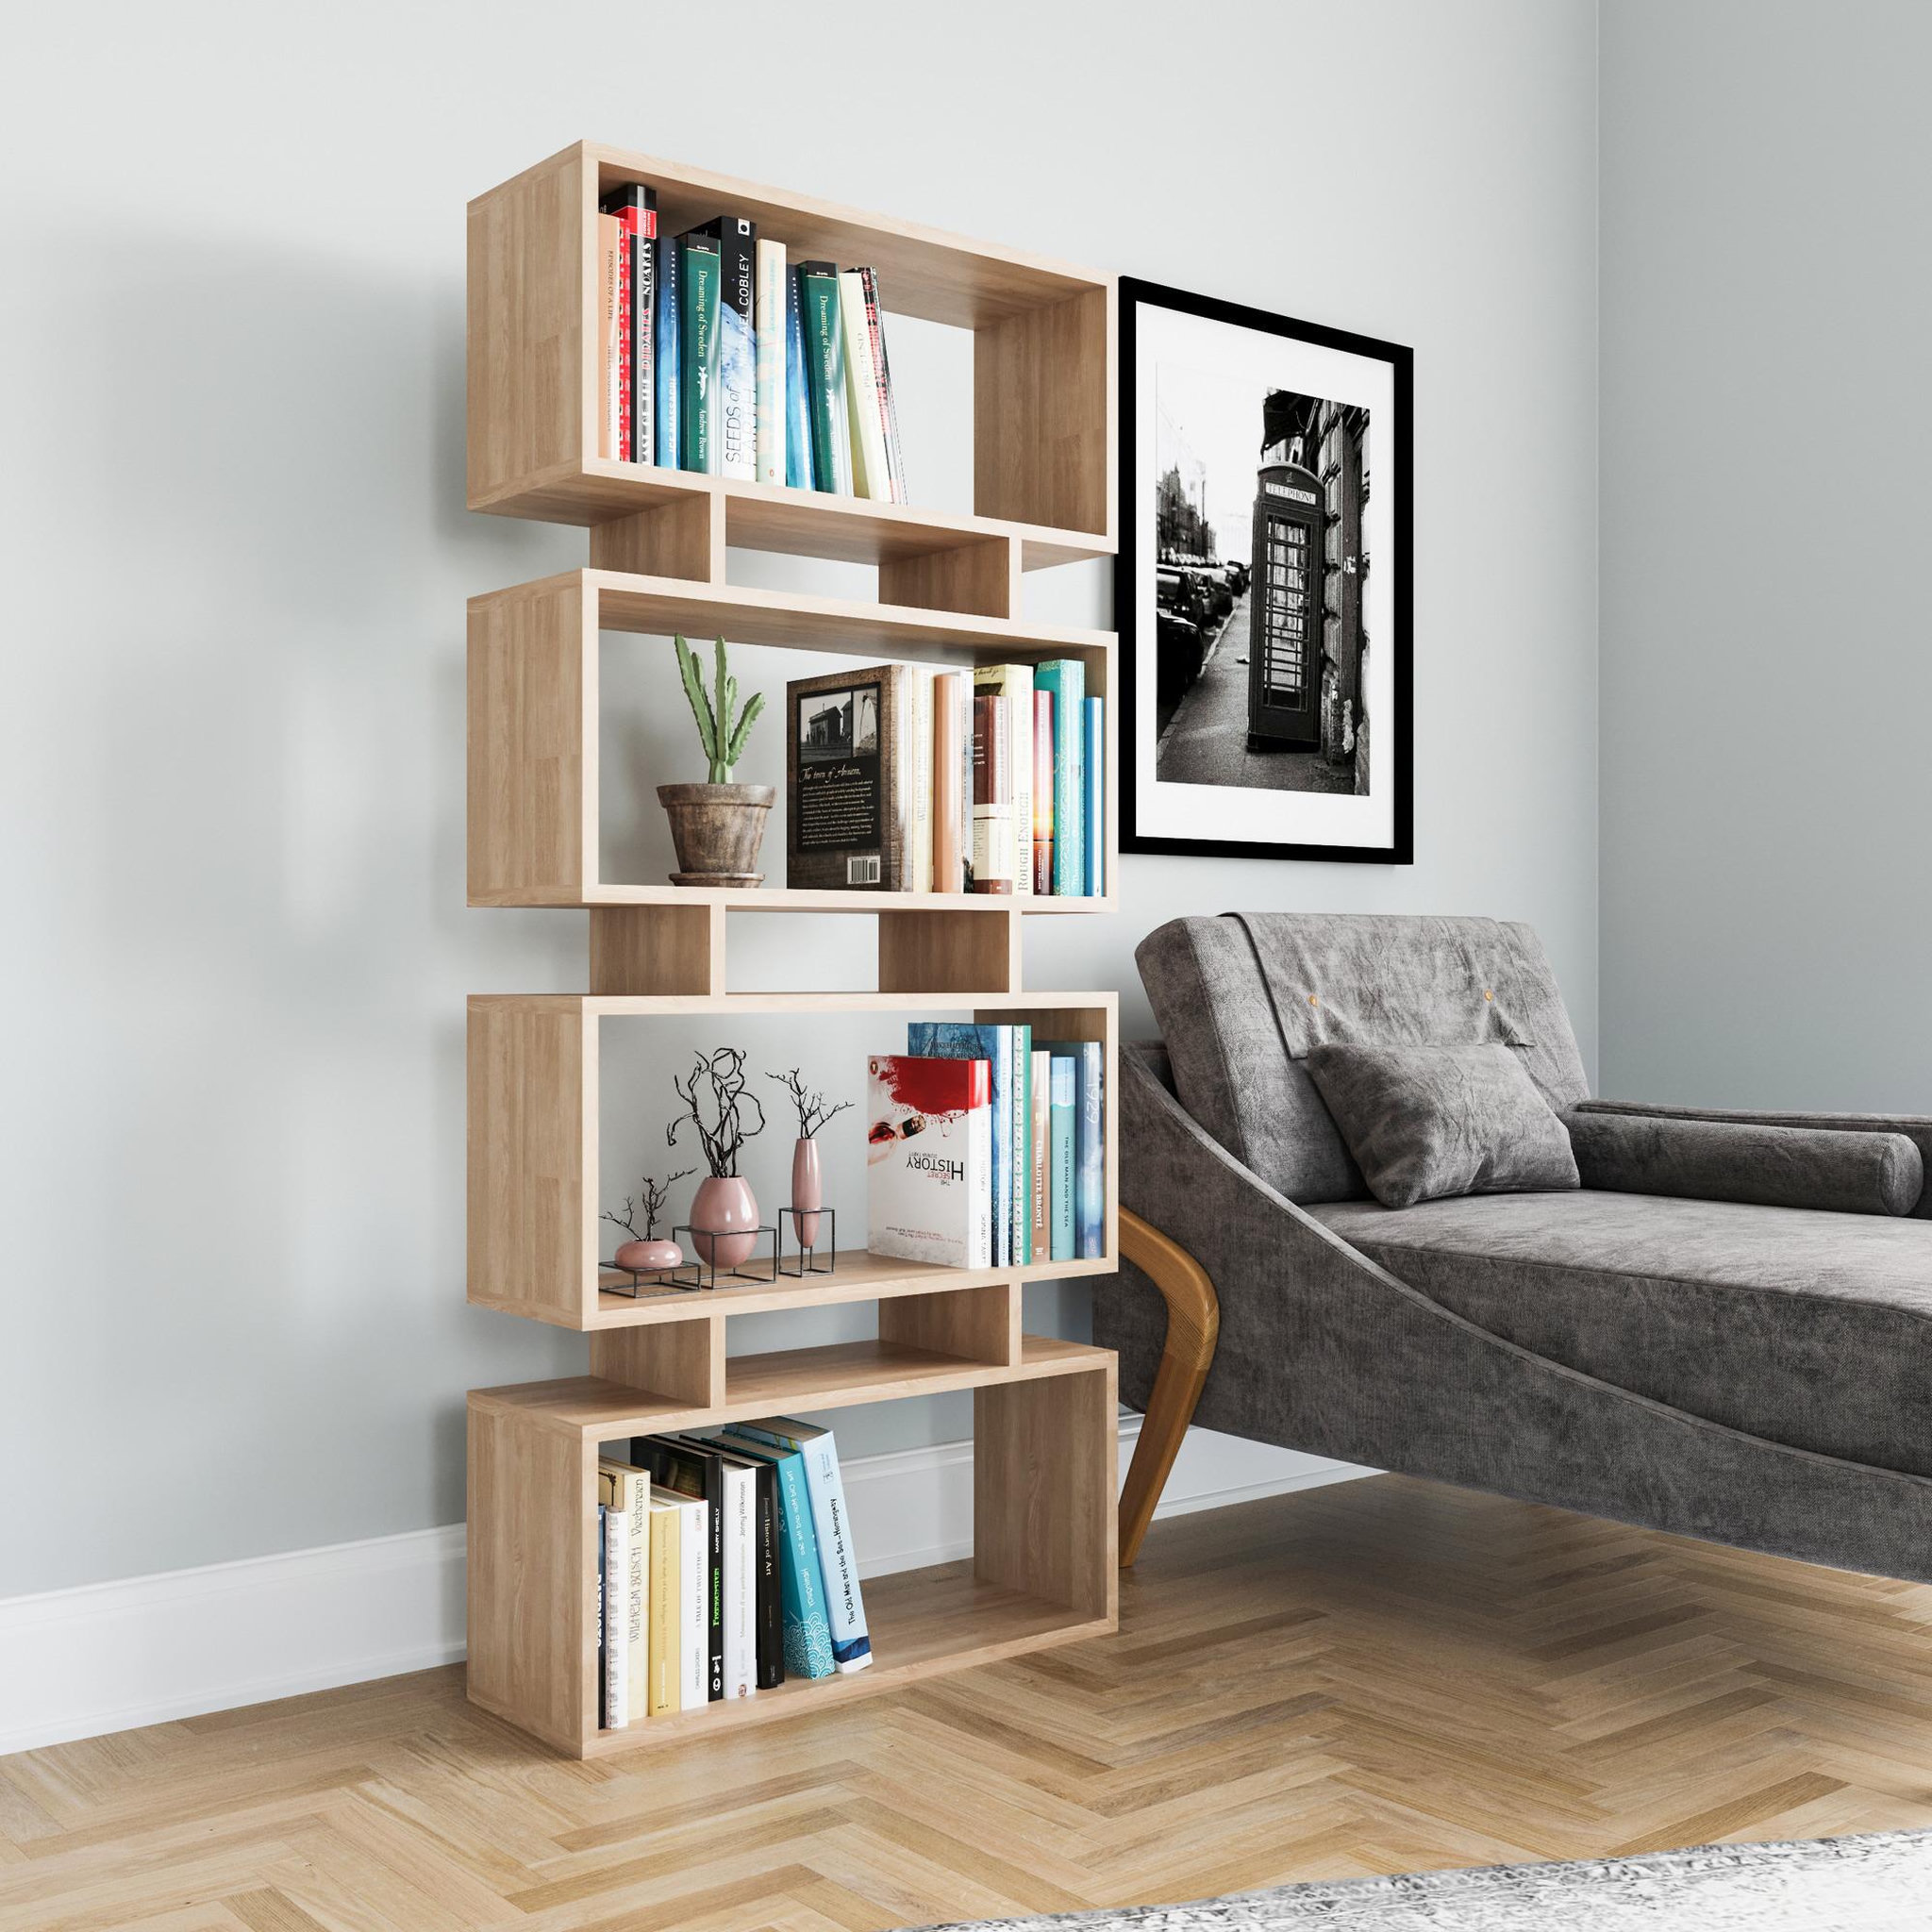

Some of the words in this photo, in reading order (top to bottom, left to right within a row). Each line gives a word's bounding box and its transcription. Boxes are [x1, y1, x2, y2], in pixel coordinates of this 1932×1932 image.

[642, 242, 652, 295] NOAKES
[739, 254, 750, 305] COBLEY
[607, 286, 614, 296] OF
[697, 270, 708, 312] Dreaming
[698, 313, 708, 323] of
[820, 294, 828, 337] Dreaming
[641, 308, 651, 370] PIRATES
[698, 324, 708, 358] Sweden
[739, 310, 750, 368] MICHAEL
[822, 338, 830, 346] of
[823, 347, 832, 380] Sweden
[641, 377, 651, 401] THE
[727, 385, 741, 402] of
[698, 408, 707, 435] Andrew
[725, 407, 741, 463] SEEDS
[698, 437, 707, 459] Brown
[1268, 482, 1314, 503] TELEPHONE
[1018, 791, 1028, 842] ENOUGH
[1018, 848, 1028, 891] ROUGH
[906, 1157, 964, 1181] HISTORY
[927, 1172, 951, 1180] SECRET
[765, 1549, 771, 1557] of
[838, 1556, 846, 1567] the
[839, 1568, 848, 1580] and
[841, 1581, 851, 1596] Man
[842, 1596, 853, 1610] Old
[845, 1611, 856, 1625] The
